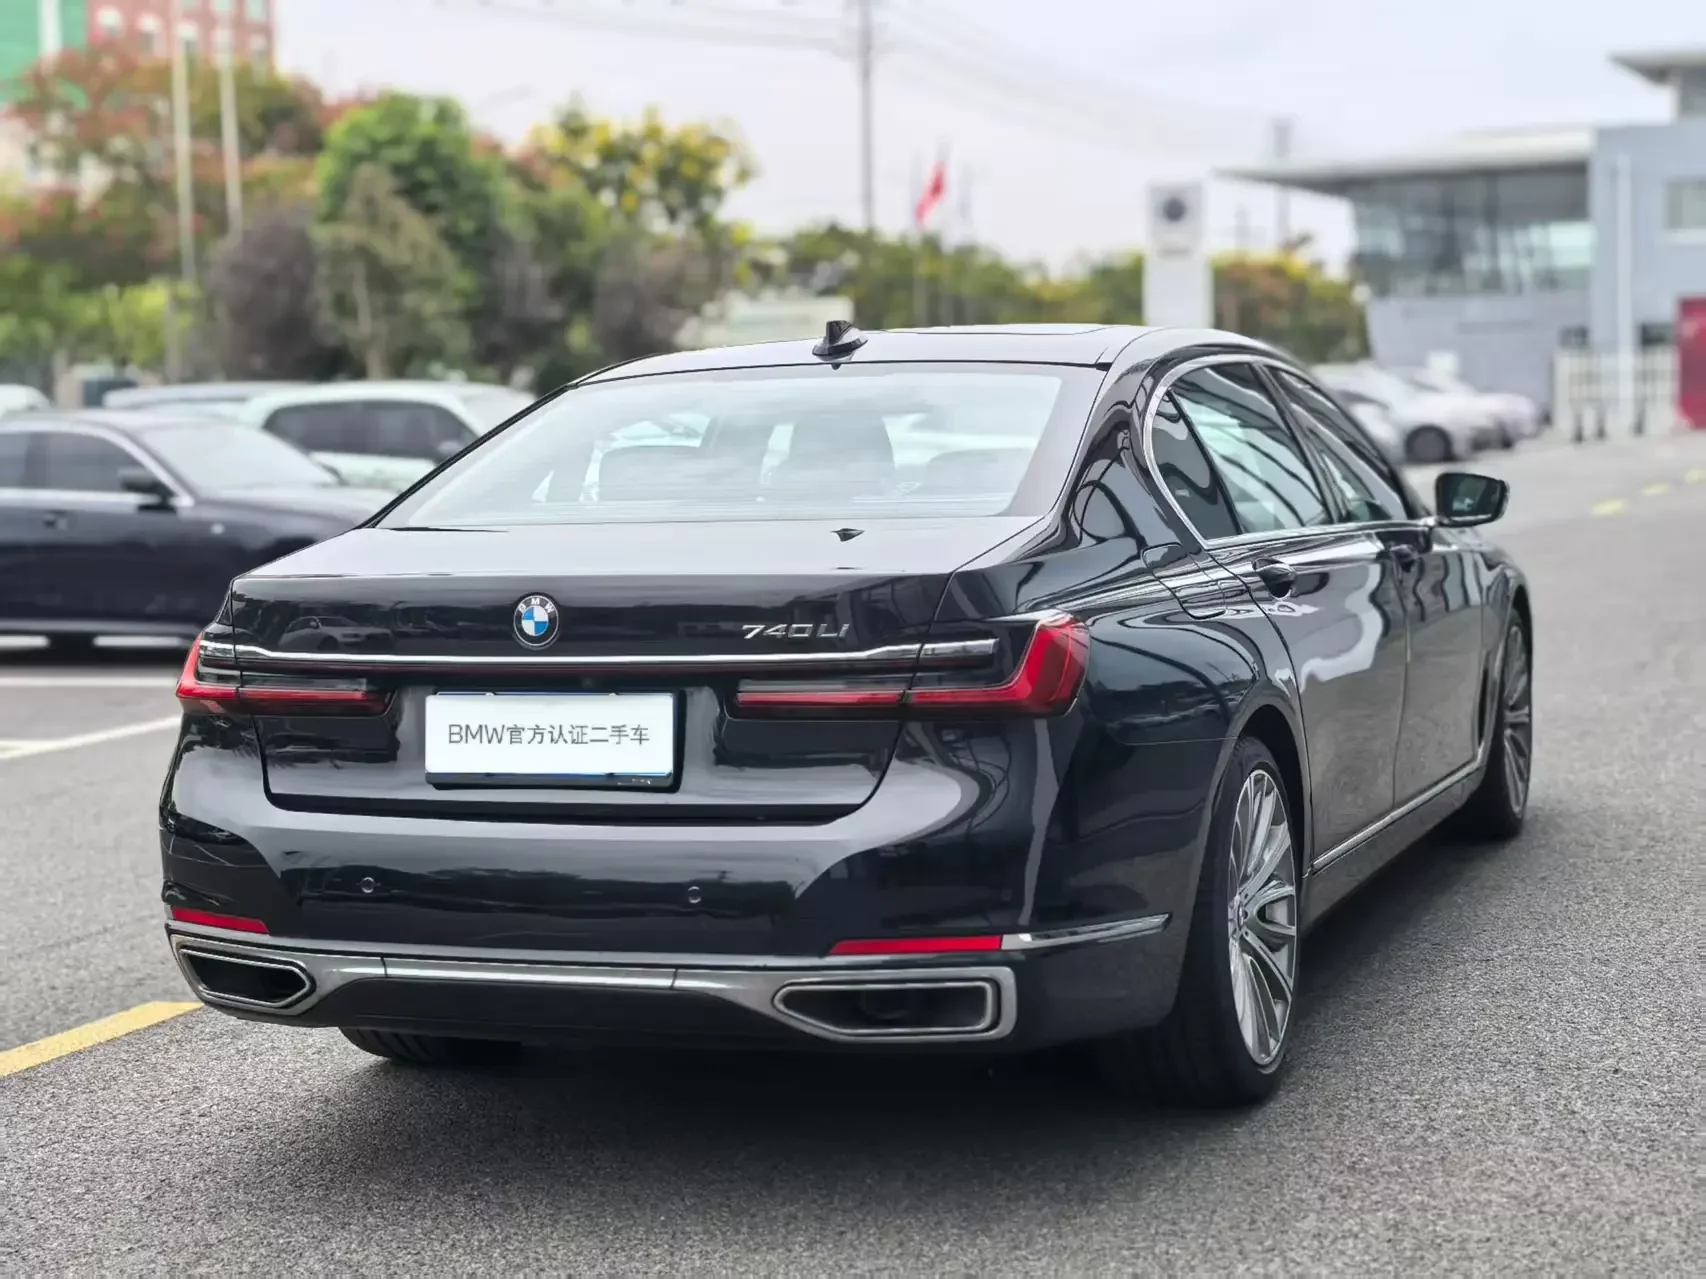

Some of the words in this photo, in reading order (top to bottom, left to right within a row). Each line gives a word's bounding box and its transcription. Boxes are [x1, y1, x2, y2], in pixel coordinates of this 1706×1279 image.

[517, 597, 555, 614] BMW
[448, 724, 650, 745] BMW官方认证二手车
